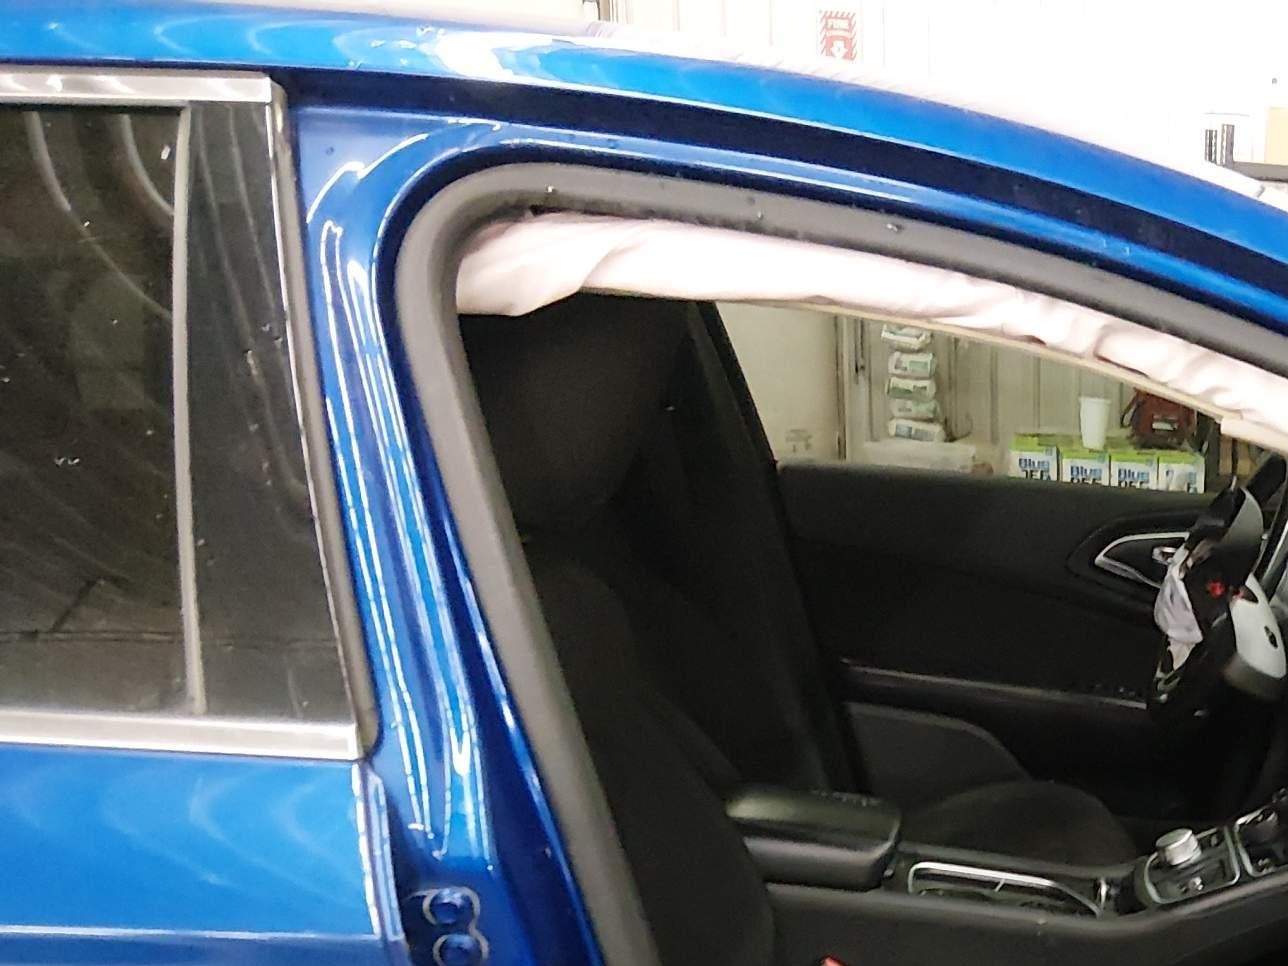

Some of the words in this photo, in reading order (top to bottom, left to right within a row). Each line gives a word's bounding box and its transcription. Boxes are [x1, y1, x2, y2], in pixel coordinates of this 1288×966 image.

[1018, 457, 1051, 472] Blue
[1070, 465, 1104, 480] Blue
[1118, 467, 1151, 482] Blue
